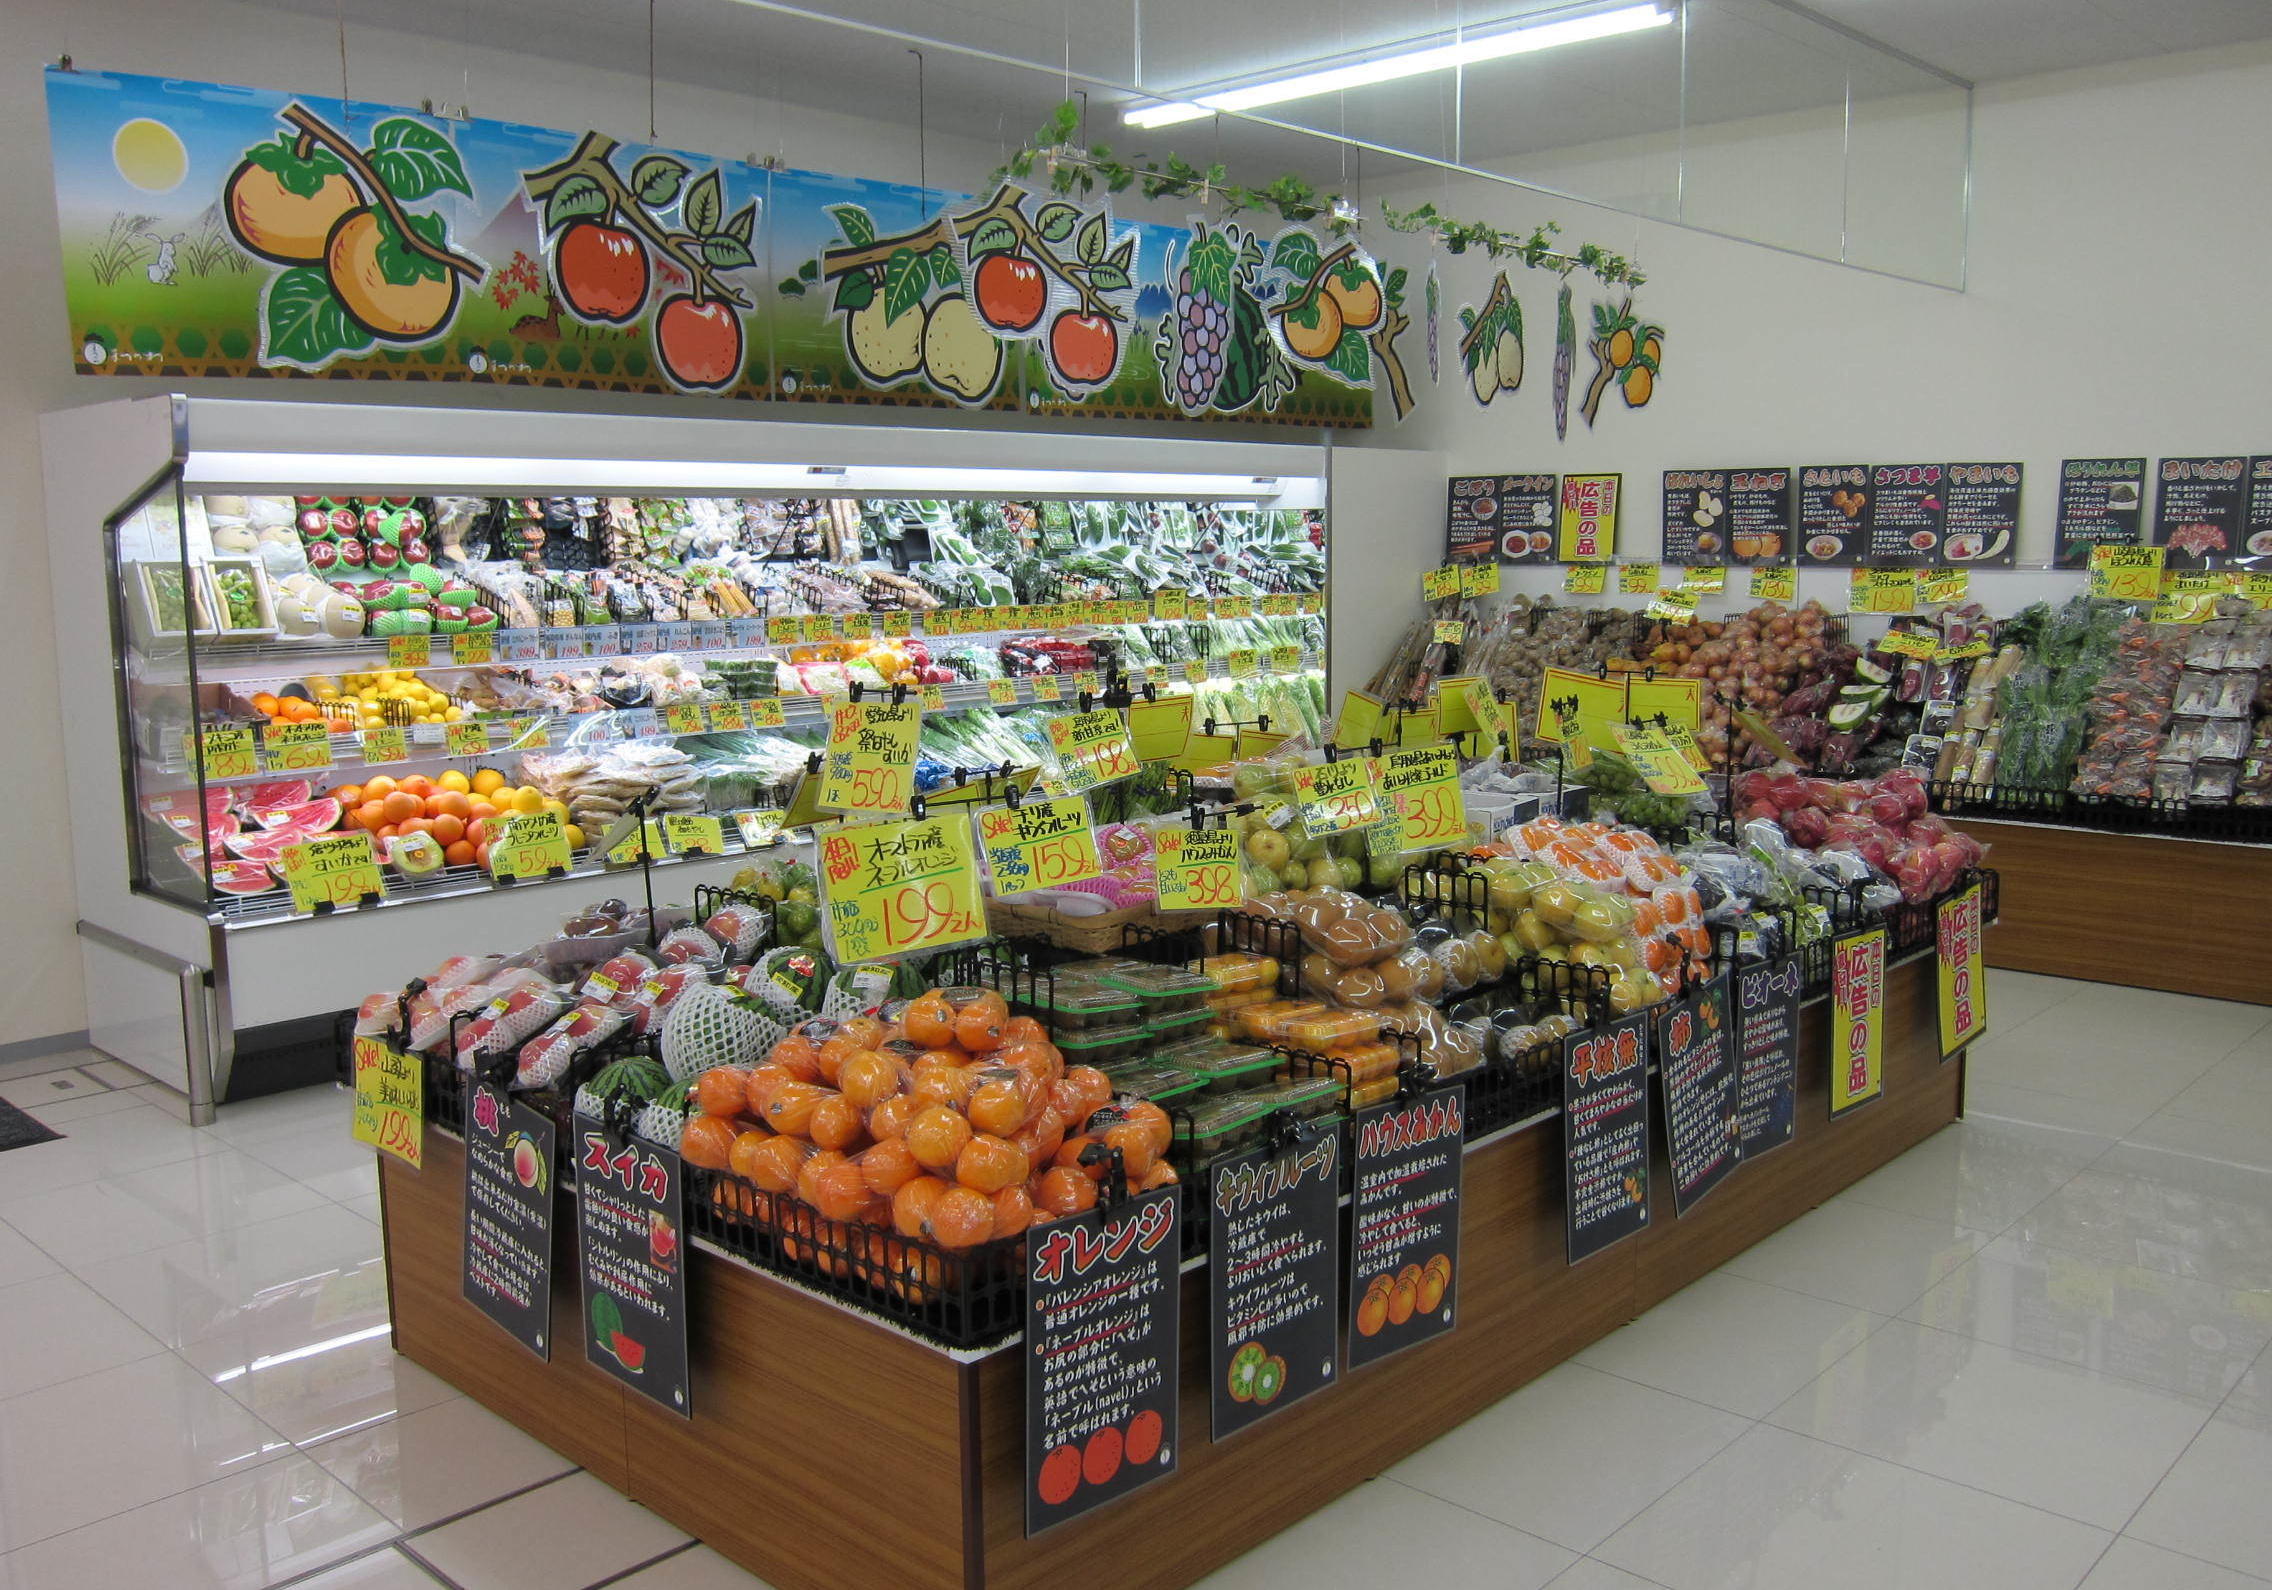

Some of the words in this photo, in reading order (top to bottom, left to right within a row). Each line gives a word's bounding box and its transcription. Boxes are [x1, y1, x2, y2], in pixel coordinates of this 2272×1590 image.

[1730, 472, 1786, 492] 玉ねぎ
[1803, 467, 1866, 487] さといも
[1874, 466, 1941, 486] さつま芋
[1949, 466, 2019, 486] やまいも
[2162, 461, 2243, 480] まいたけ
[1576, 480, 1601, 557] 広告の品
[1602, 480, 1616, 516] 本日の
[1741, 961, 1799, 1010] ピオーネ
[1951, 899, 1974, 1041] 広告の品
[1669, 1010, 1692, 1058] 柿
[1848, 942, 1870, 1098] 広告の品
[1570, 1027, 1639, 1089] 平核無
[473, 1085, 500, 1138] 桃
[1359, 1095, 1462, 1160] ハウスみかん
[584, 1131, 670, 1204] スイカ
[1215, 1134, 1337, 1218] キウイフルーツ
[1360, 1183, 1402, 1206] みかんです。
[1032, 1196, 1175, 1286] オレンジ
[1227, 1227, 1267, 1255] 冷蔵庫で
[1226, 1270, 1296, 1312] キウイフルーツは
[1043, 1351, 1125, 1393] あるのが特徴で、
[1043, 1357, 1158, 1414] 英語でへそという意味の
[1043, 1406, 1136, 1450] 名前で呼ばれます。
